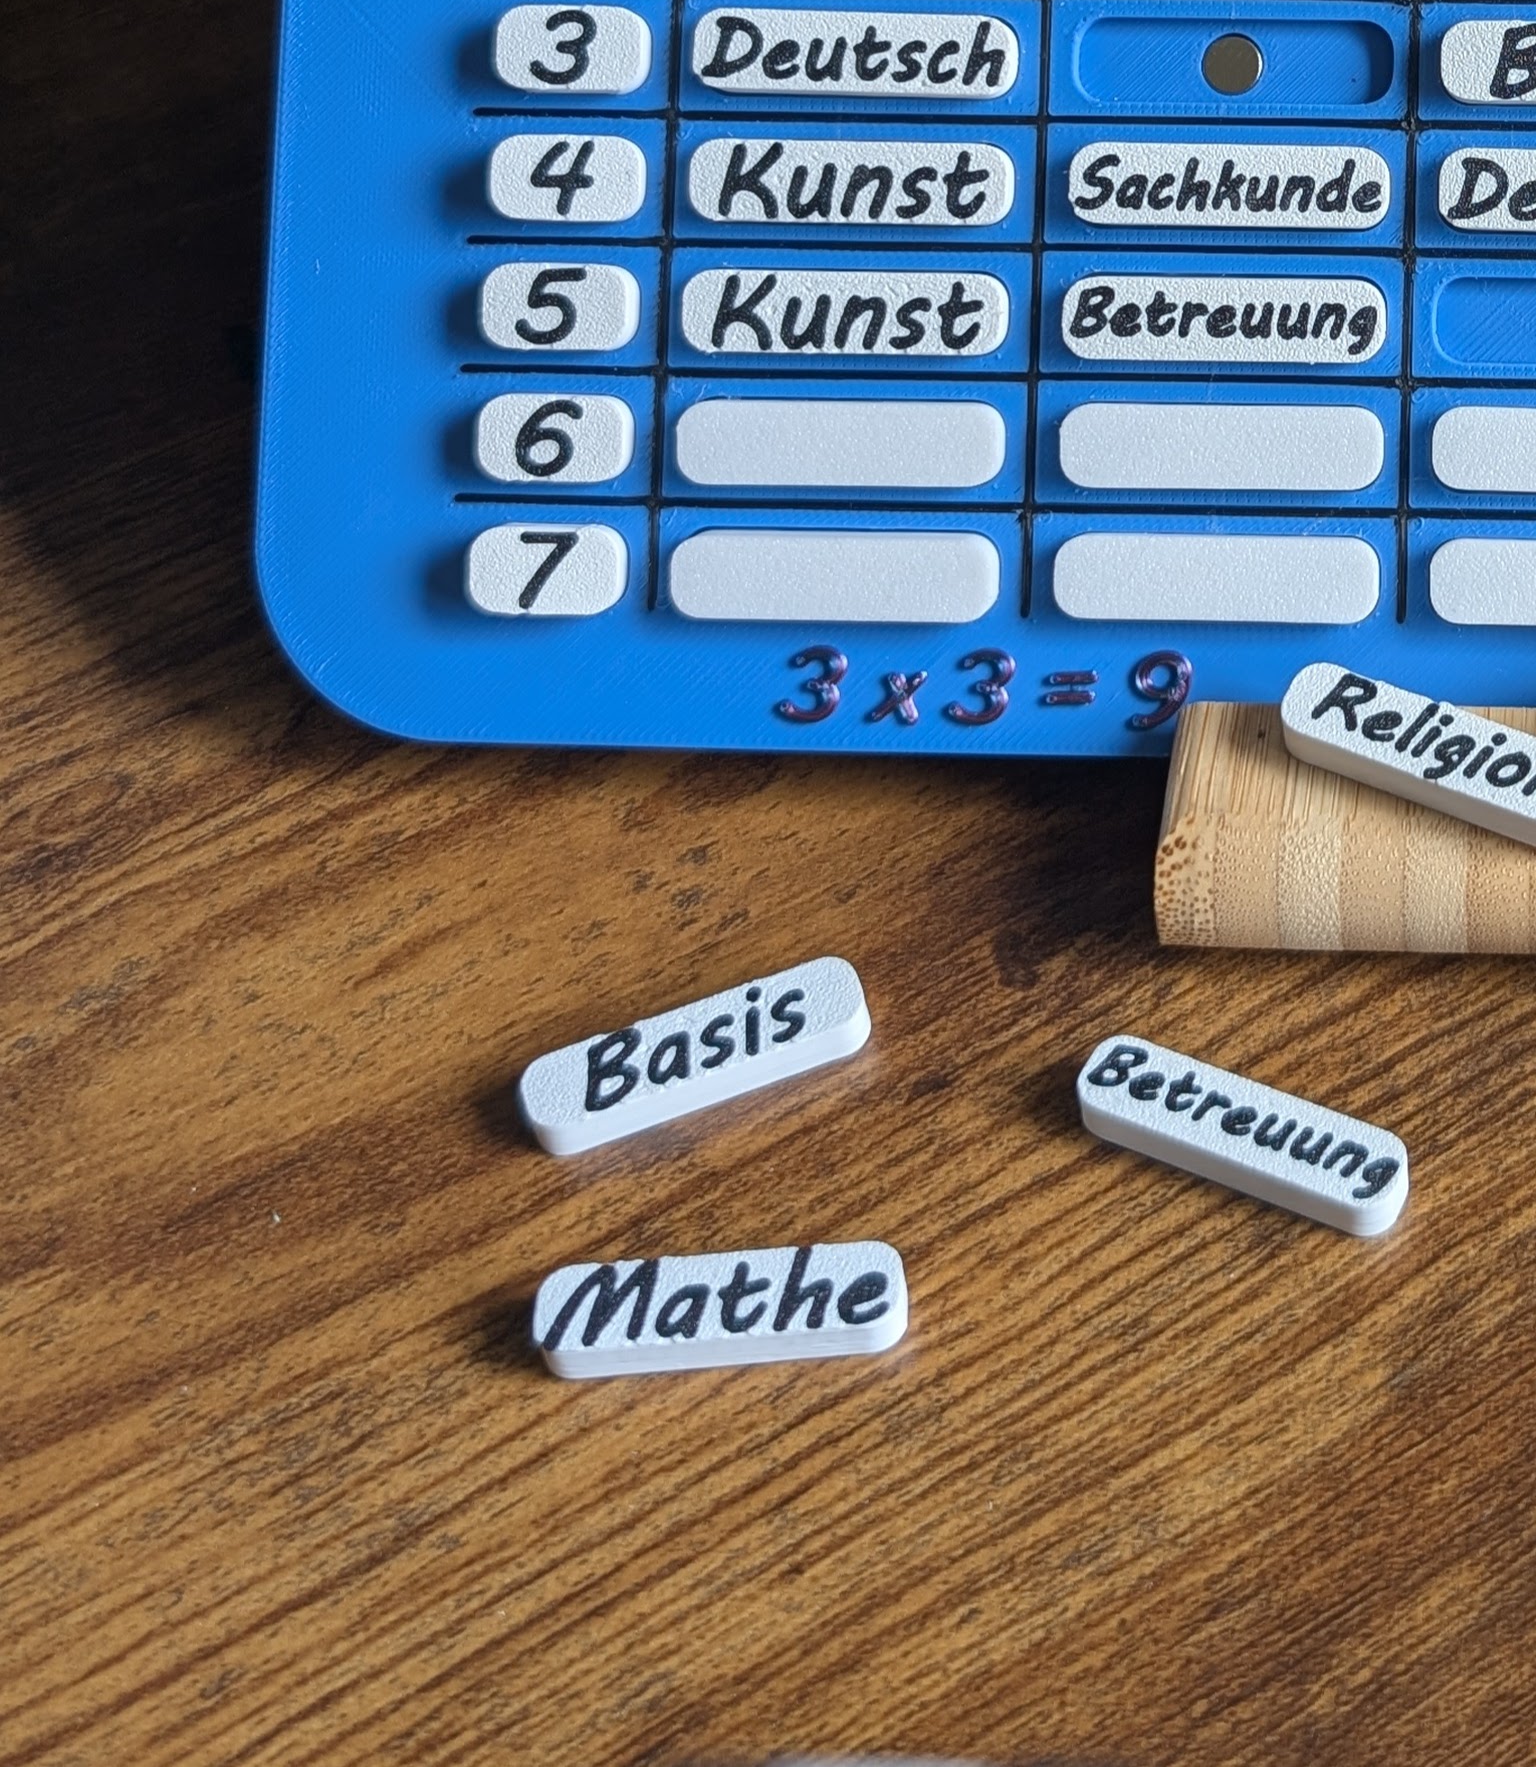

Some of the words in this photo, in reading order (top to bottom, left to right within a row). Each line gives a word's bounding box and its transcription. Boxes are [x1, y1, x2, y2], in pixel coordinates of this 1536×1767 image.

[530, 10, 598, 85] 3
[701, 17, 1007, 87] Deutsch
[530, 142, 595, 216] 4
[718, 143, 992, 220] Kunst
[1074, 155, 1384, 213] Sachkunde
[514, 269, 588, 345] 5
[711, 275, 985, 351] Kunst
[1069, 286, 1380, 355] Betreuung
[515, 401, 583, 477] 6
[518, 533, 577, 609] 7
[585, 983, 807, 1111] Basis
[1086, 1044, 1400, 1201] Betreuung
[541, 1242, 891, 1353] Mathe
